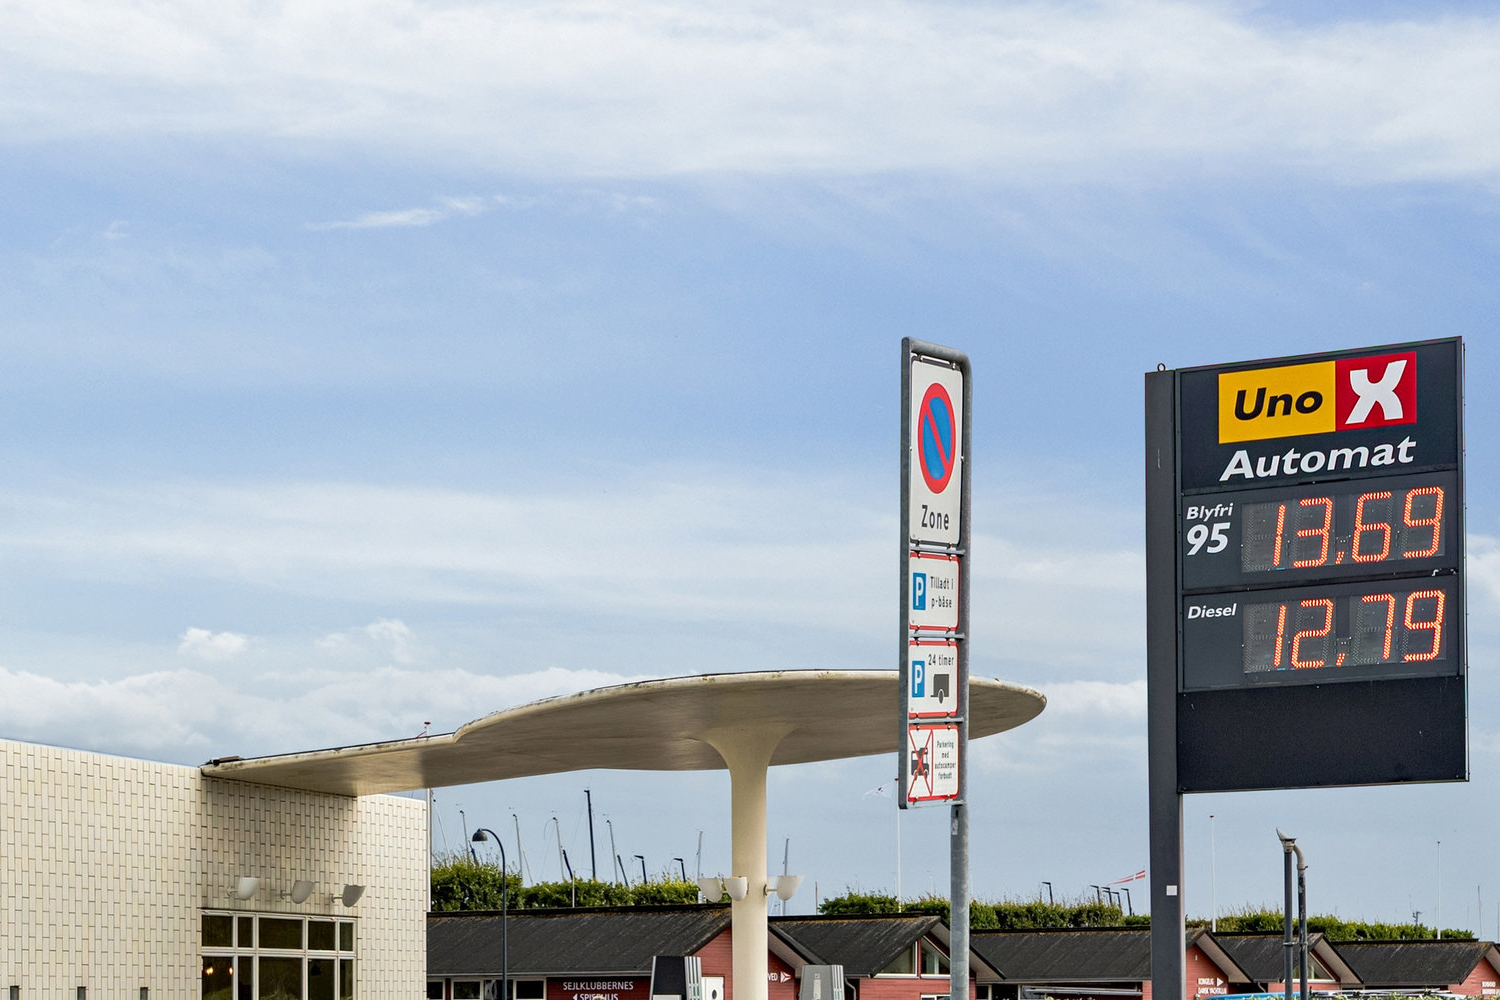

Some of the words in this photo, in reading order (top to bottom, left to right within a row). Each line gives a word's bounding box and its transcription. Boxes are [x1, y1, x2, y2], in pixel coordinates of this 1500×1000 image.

[1234, 387, 1323, 421] Uno
[1345, 359, 1408, 425] X
[1219, 436, 1417, 482] Automat
[921, 504, 950, 531] Zone
[1186, 502, 1234, 522] Blyfri
[1273, 486, 1445, 568] 13,69
[1186, 522, 1231, 556] 95
[915, 576, 924, 607] P
[930, 576, 949, 589] Tilladt
[1187, 603, 1237, 620] Diesel
[1273, 589, 1445, 669] 12,79
[928, 653, 936, 666] 24
[938, 653, 954, 666] timer
[914, 664, 923, 695] P
[562, 981, 634, 991] SEJLKLUBBERNES
